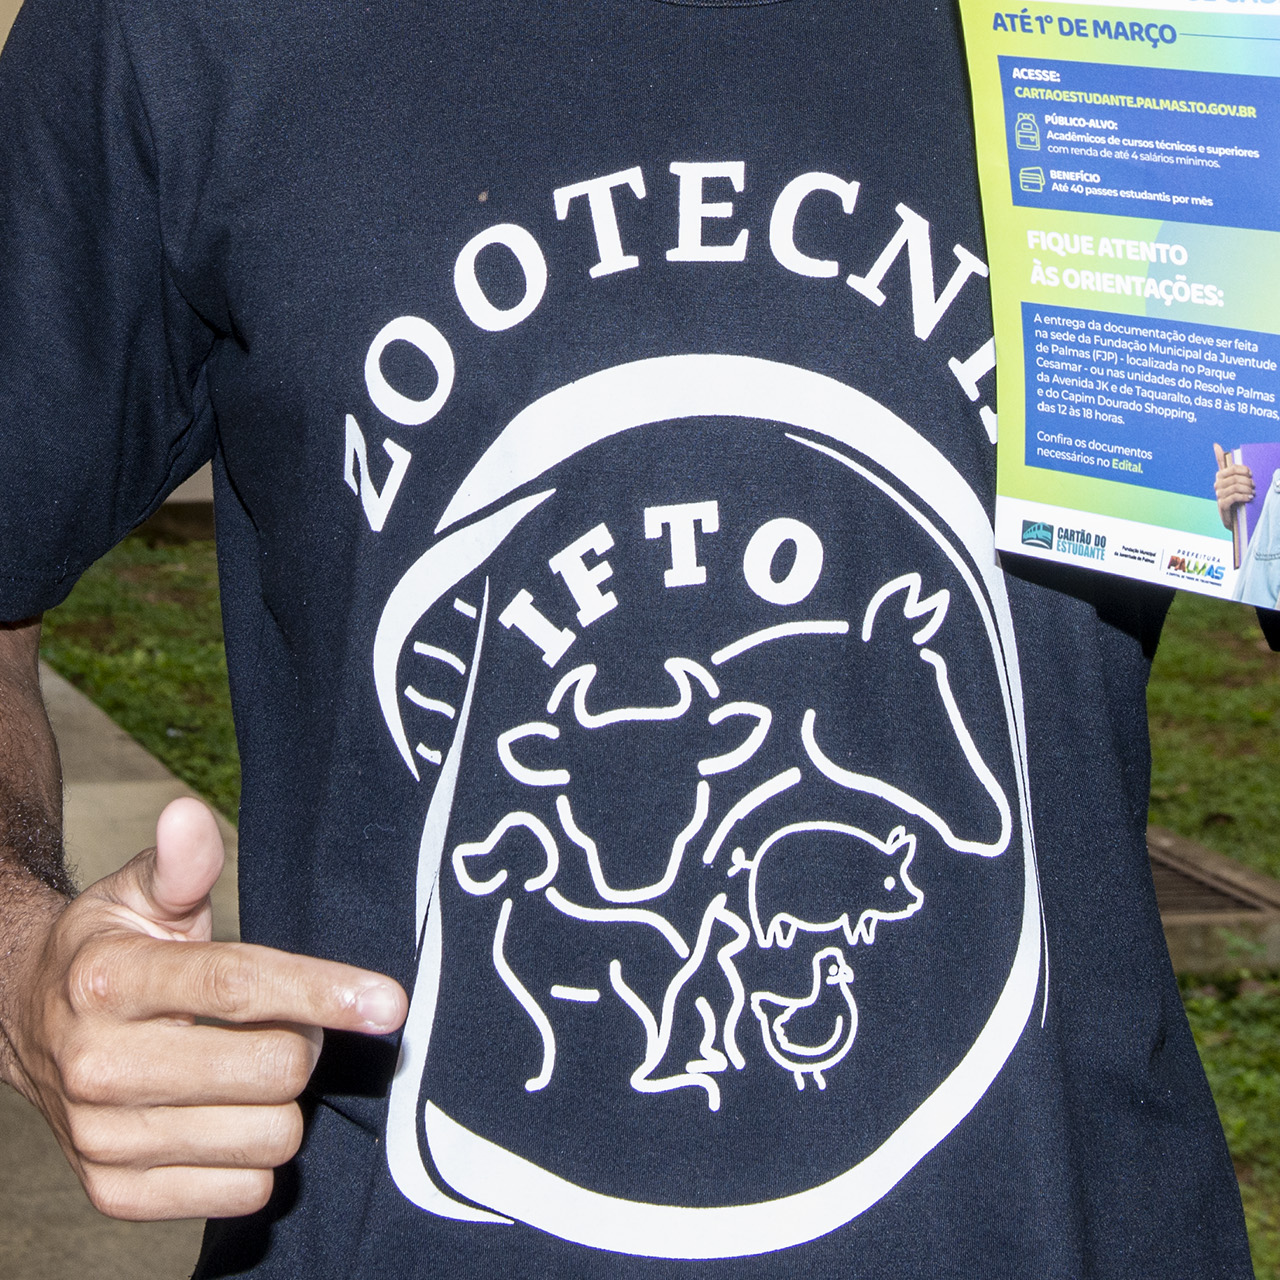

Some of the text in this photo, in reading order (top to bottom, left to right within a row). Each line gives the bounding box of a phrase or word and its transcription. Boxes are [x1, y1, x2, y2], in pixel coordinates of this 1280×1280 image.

[992, 8, 1032, 34] ATÉ
[1058, 17, 1088, 38] DE
[1093, 22, 1176, 48] MARÇO
[1012, 68, 1061, 82] ACESSE:
[1014, 86, 1257, 118] CARTAOESTUDANTE.PALMAS.TO.GOV.BR
[1045, 113, 1118, 130] PÚBLICO-ALVO:
[1047, 130, 1260, 158] Acadêmicos de cursos técnicos e superiores
[1047, 145, 1069, 154] com
[1071, 146, 1098, 157] renda
[1100, 148, 1112, 158] de
[1114, 149, 1129, 159] até
[1131, 151, 1138, 160] 4
[1139, 152, 1174, 164] salários
[1050, 169, 1100, 183] BENEFÍCIO
[1052, 182, 1213, 206] Até 40 passes estudantis por mês
[1027, 229, 1187, 267] FIQUE ATENTO
[1030, 260, 1224, 306] ÀS ORIENTAÇÕES:
[344, 160, 998, 533] ZOOTECNI
[1034, 313, 1259, 352] A entrega da documentação deve ser feita
[1035, 329, 1277, 371] na sede da Fundação Municipal da Juventude
[1036, 342, 1049, 353] de
[1051, 344, 1090, 359] Palmas
[1093, 349, 1118, 365] (FJP)
[1126, 354, 1178, 371] localizada
[1181, 364, 1195, 374] no
[1197, 365, 1236, 380] Parque
[1036, 357, 1082, 372] Cesamar
[1090, 366, 1104, 375] ou
[1106, 368, 1125, 379] nas
[1127, 371, 1176, 386] unidades
[1178, 378, 1192, 389] do
[1194, 379, 1234, 396] Resolve
[1236, 386, 1275, 402] Palmas
[1037, 372, 1280, 421] da Avenida JK e de Taquaralto, das 8 às 18 horas,
[1037, 388, 1197, 423] e do Capim Dourado Shopping,
[1037, 401, 1125, 424] das 12 às 18 horas.
[1037, 431, 1153, 460] Confira os documentos
[1037, 447, 1143, 474] necessários no Edital.
[1056, 540, 1105, 560] ESTUDANTE
[1057, 527, 1107, 548] CARTÃO DO
[1167, 555, 1226, 580] PALMAS
[1177, 549, 1221, 563] PREFEITURA
[498, 500, 825, 667] IFTO
